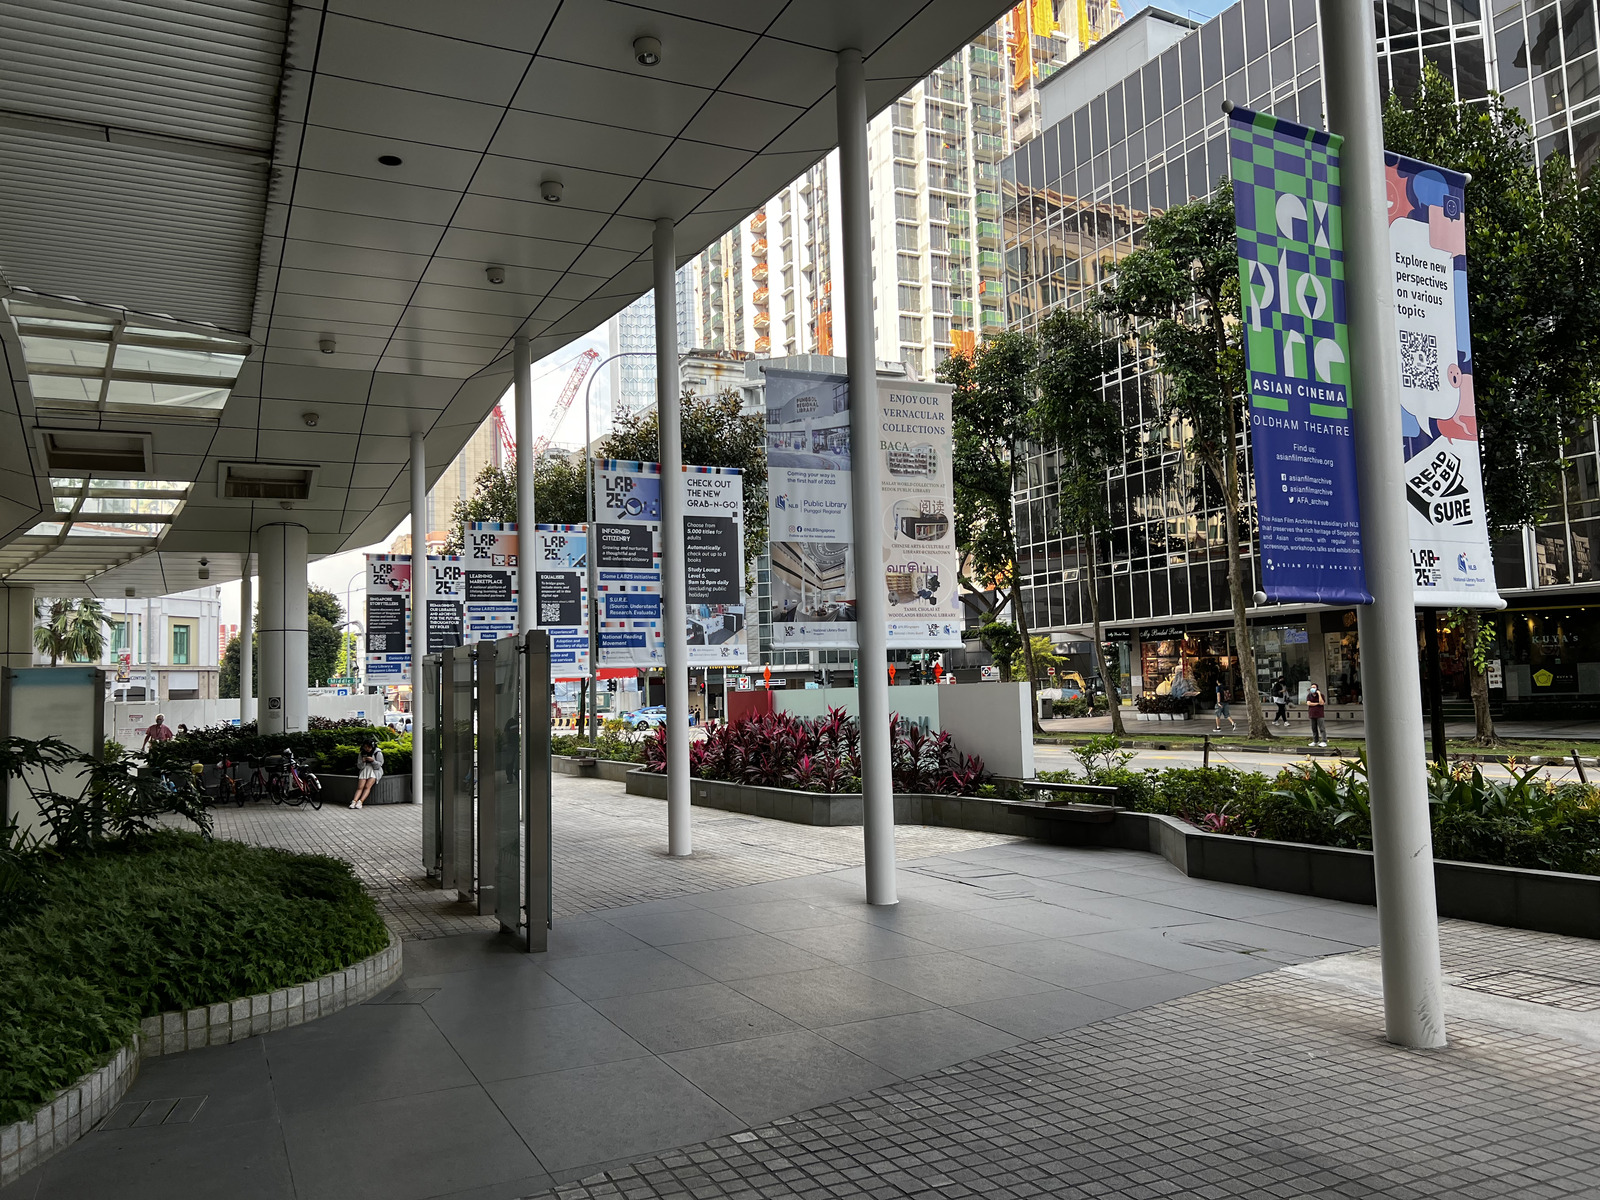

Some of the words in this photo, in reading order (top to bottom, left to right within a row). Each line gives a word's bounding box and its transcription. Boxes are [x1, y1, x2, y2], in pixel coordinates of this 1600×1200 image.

[1396, 252, 1427, 269] Explore
[1430, 260, 1446, 274] new
[1396, 271, 1448, 291] perspectives
[1397, 288, 1408, 299] on
[1411, 290, 1442, 306] various
[1398, 304, 1425, 319] topics
[1254, 379, 1292, 395] ASIAN
[1298, 386, 1344, 402] CINEMA
[890, 394, 918, 405] ENJOY
[920, 396, 938, 405] OUR
[884, 408, 944, 420] VERNACULAR
[882, 423, 945, 435] COLLECTIONS
[1253, 415, 1299, 430] OLDHAM
[1304, 421, 1350, 436] THEATRE
[880, 441, 909, 451] BACA
[1293, 444, 1307, 452] Find
[1276, 453, 1334, 467] asianfilmarchive.org
[1410, 451, 1447, 489] READ
[606, 476, 634, 492] LAB
[687, 479, 712, 487] CHECK
[1289, 475, 1332, 485] asianfilmarchive
[1421, 480, 1441, 497] TO
[1440, 459, 1456, 482] BE
[687, 489, 701, 497] THE
[1290, 486, 1333, 496] asianfilmarchive
[606, 492, 624, 508] 25
[687, 500, 738, 509] GRAB-N-GO!
[825, 501, 847, 509] Library
[1297, 497, 1329, 506] AFA_archive
[920, 500, 944, 514] 阅读
[1434, 498, 1471, 523] SURE
[473, 534, 496, 546] LAB
[544, 536, 566, 548] LAB
[474, 547, 490, 558] 25
[544, 549, 560, 560] 25
[373, 564, 393, 574] LAB
[435, 567, 461, 580] LAB
[887, 562, 939, 577] வாசிப்பு
[436, 581, 452, 594] 25
[1140, 630, 1150, 639] My
